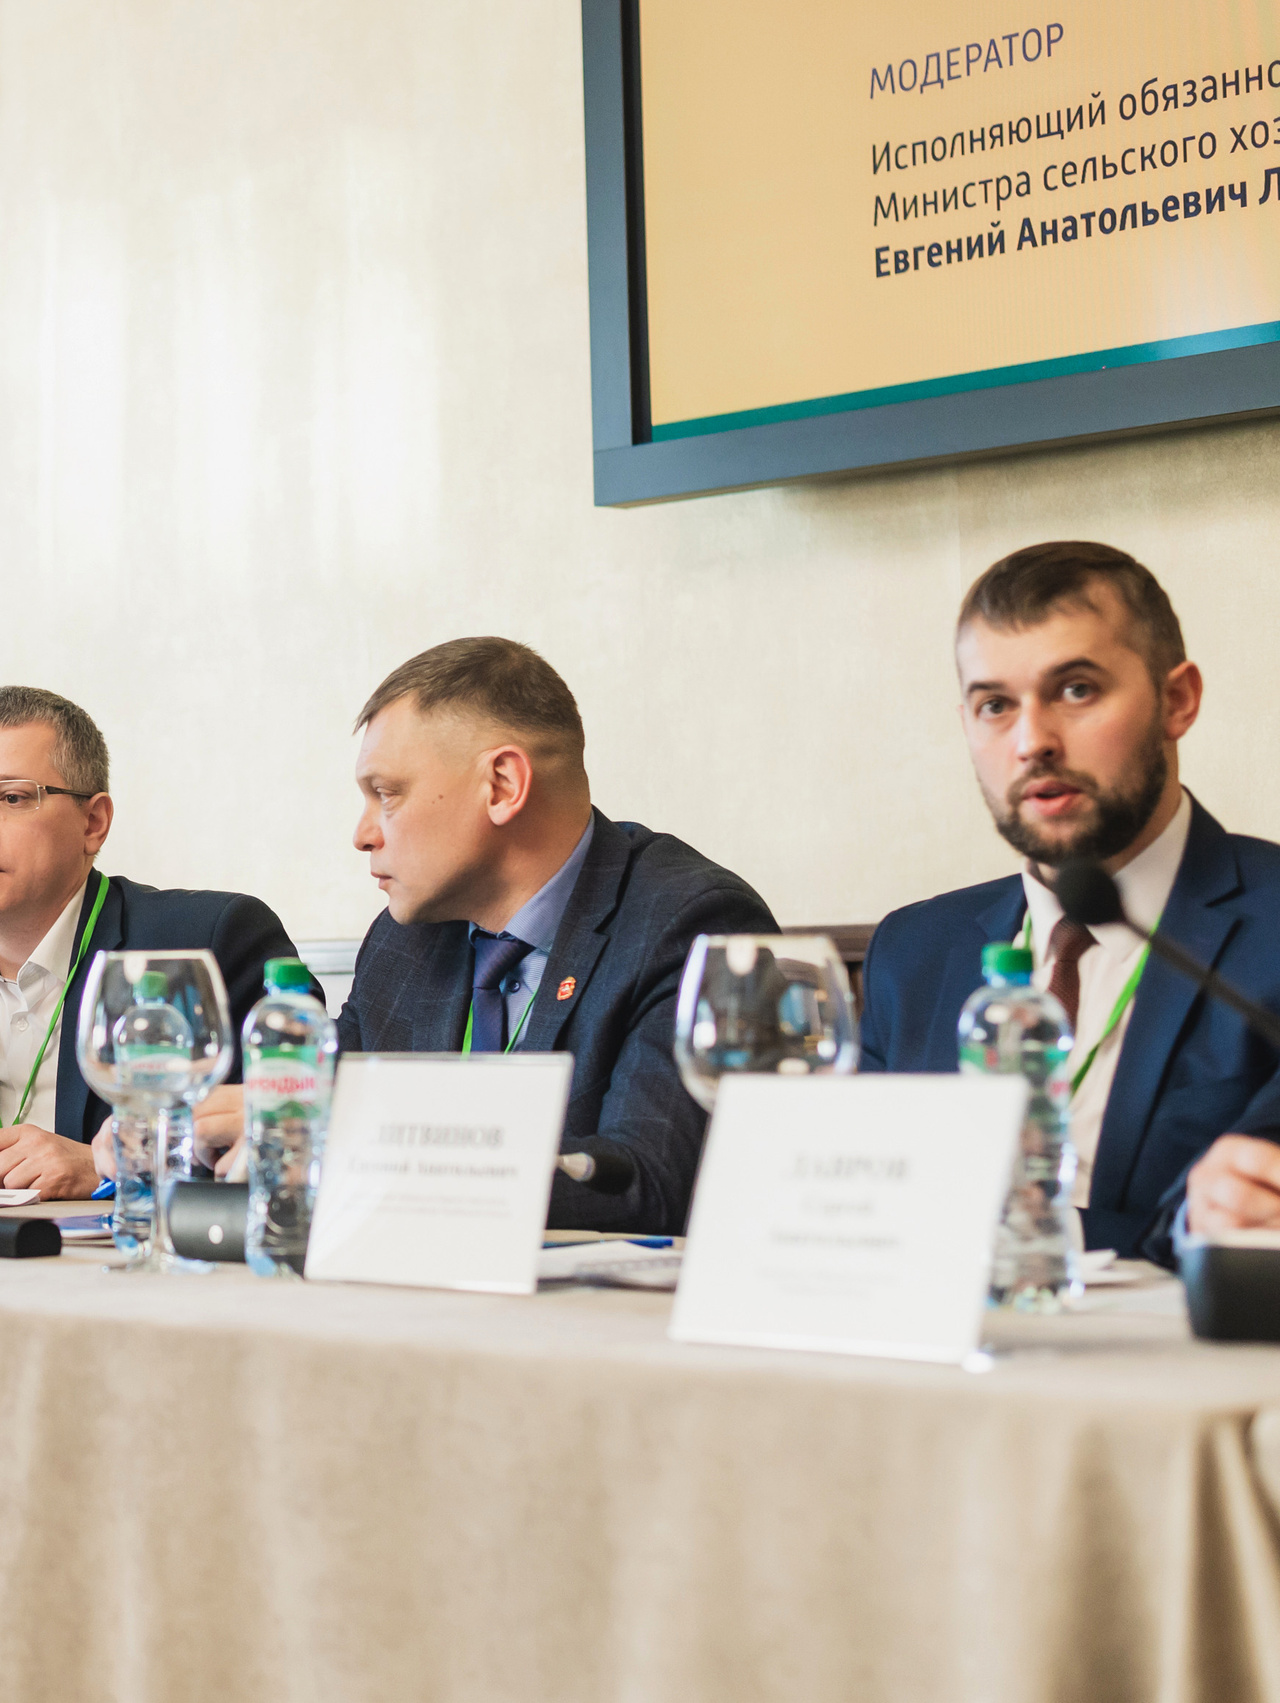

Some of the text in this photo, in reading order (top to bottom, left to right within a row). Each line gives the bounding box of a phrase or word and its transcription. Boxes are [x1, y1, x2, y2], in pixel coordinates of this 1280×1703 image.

[869, 23, 1064, 99] МОДЕРАТОР
[872, 92, 1107, 175] Исполняющий
[873, 170, 1031, 227] Министра
[1043, 131, 1217, 192] сельского
[875, 221, 1006, 278] Евгений
[1017, 179, 1248, 251] Анатольевич
